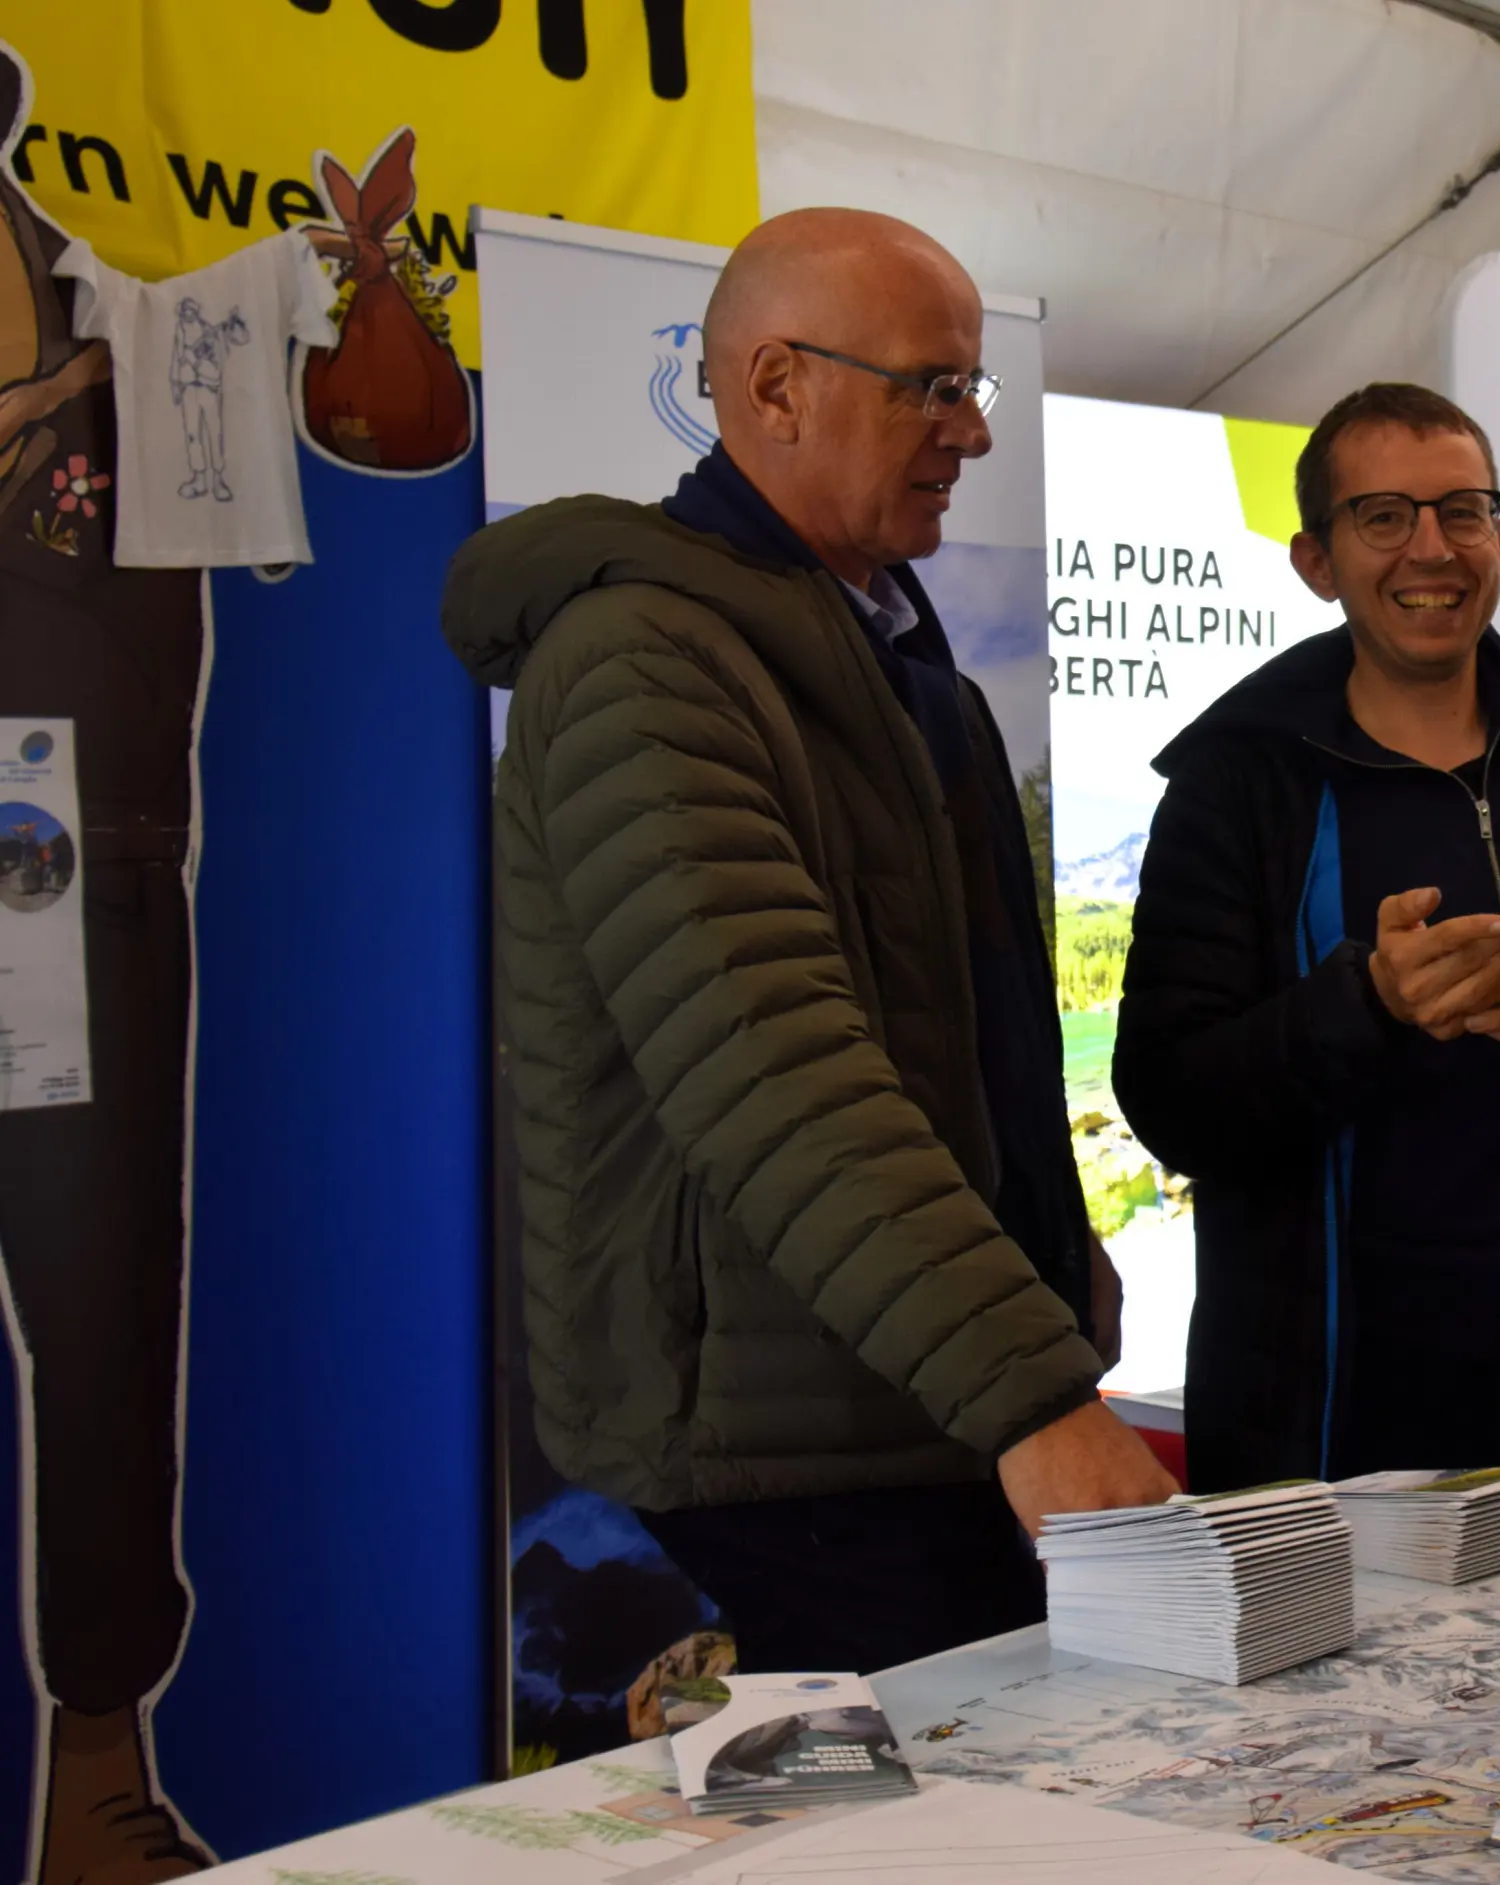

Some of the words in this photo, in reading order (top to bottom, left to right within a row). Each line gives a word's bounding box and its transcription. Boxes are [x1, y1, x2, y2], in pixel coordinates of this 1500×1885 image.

[1057, 537, 1095, 579] IA
[1114, 542, 1223, 589] PURA
[1049, 596, 1127, 640] GHI
[1146, 603, 1275, 647] ALPINI
